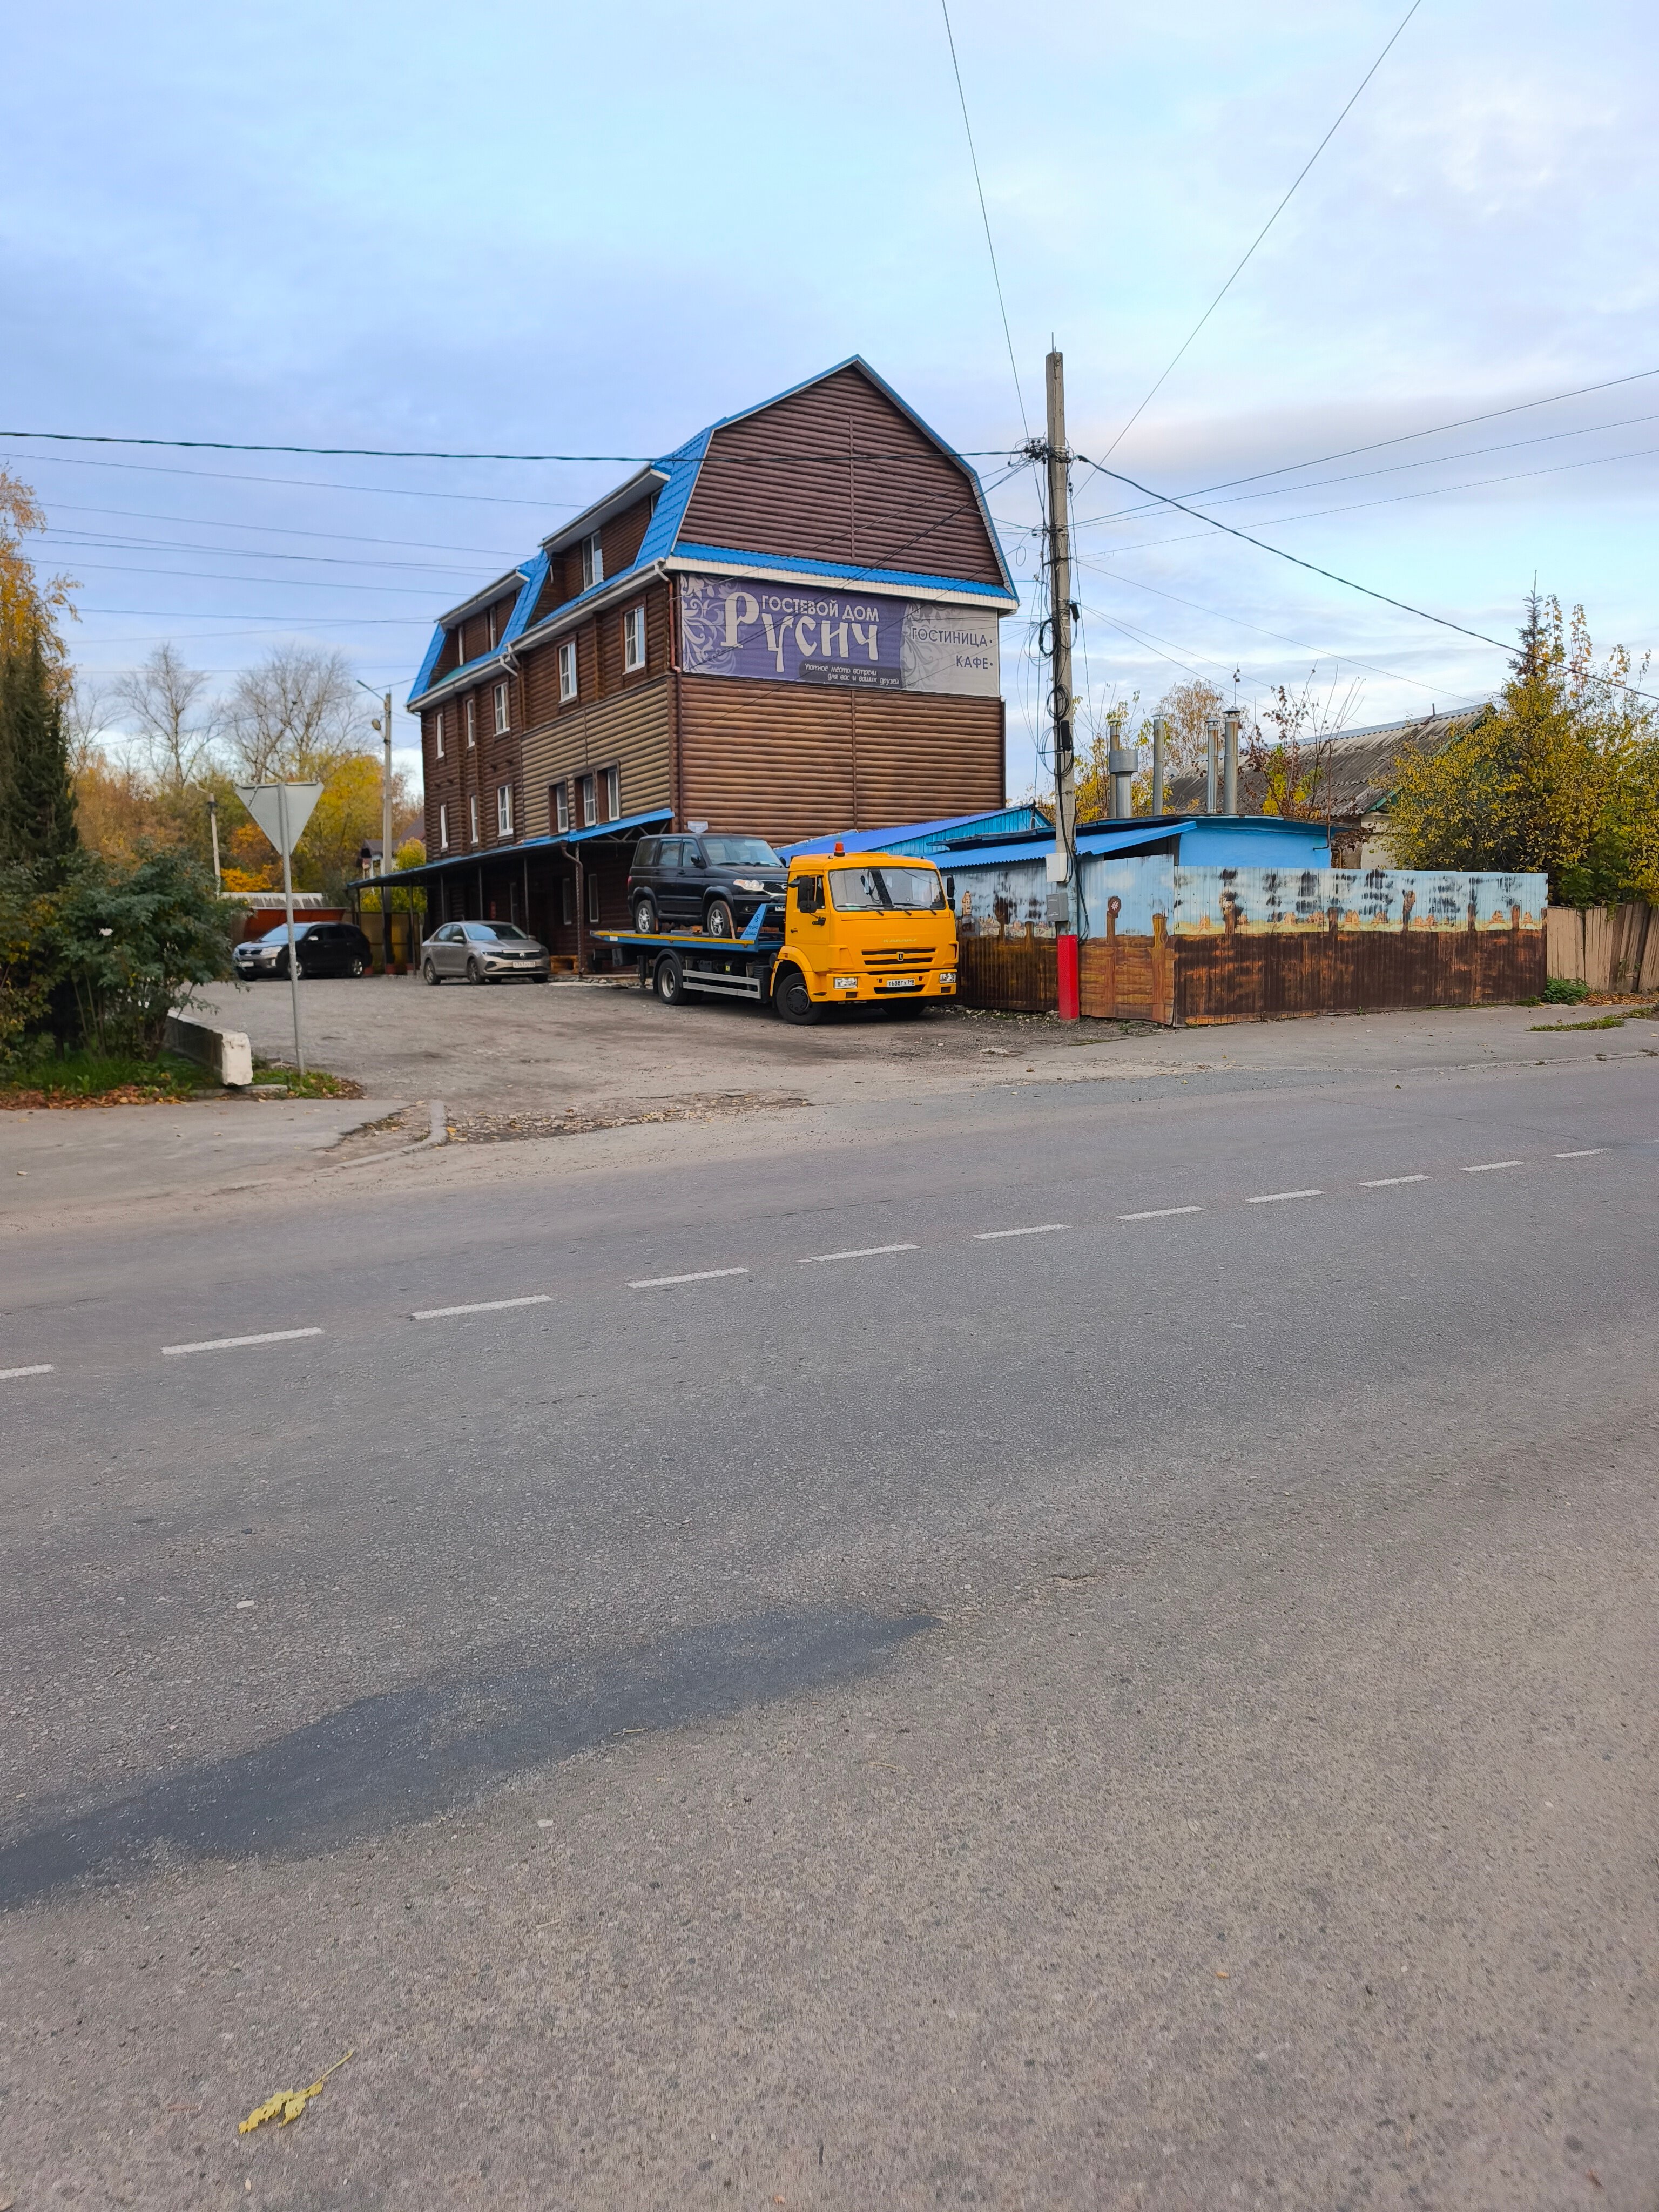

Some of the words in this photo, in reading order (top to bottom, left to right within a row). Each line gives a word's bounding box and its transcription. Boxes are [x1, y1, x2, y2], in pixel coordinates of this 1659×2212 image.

[761, 595, 838, 617] ГОСТЕВОЙ
[842, 605, 879, 622] ДОМ
[912, 627, 988, 648] ГОСТИНИЦА
[805, 663, 828, 672] Уютное
[853, 668, 877, 676] встречи
[956, 655, 988, 670] КАФЕ
[879, 678, 899, 686] друзей
